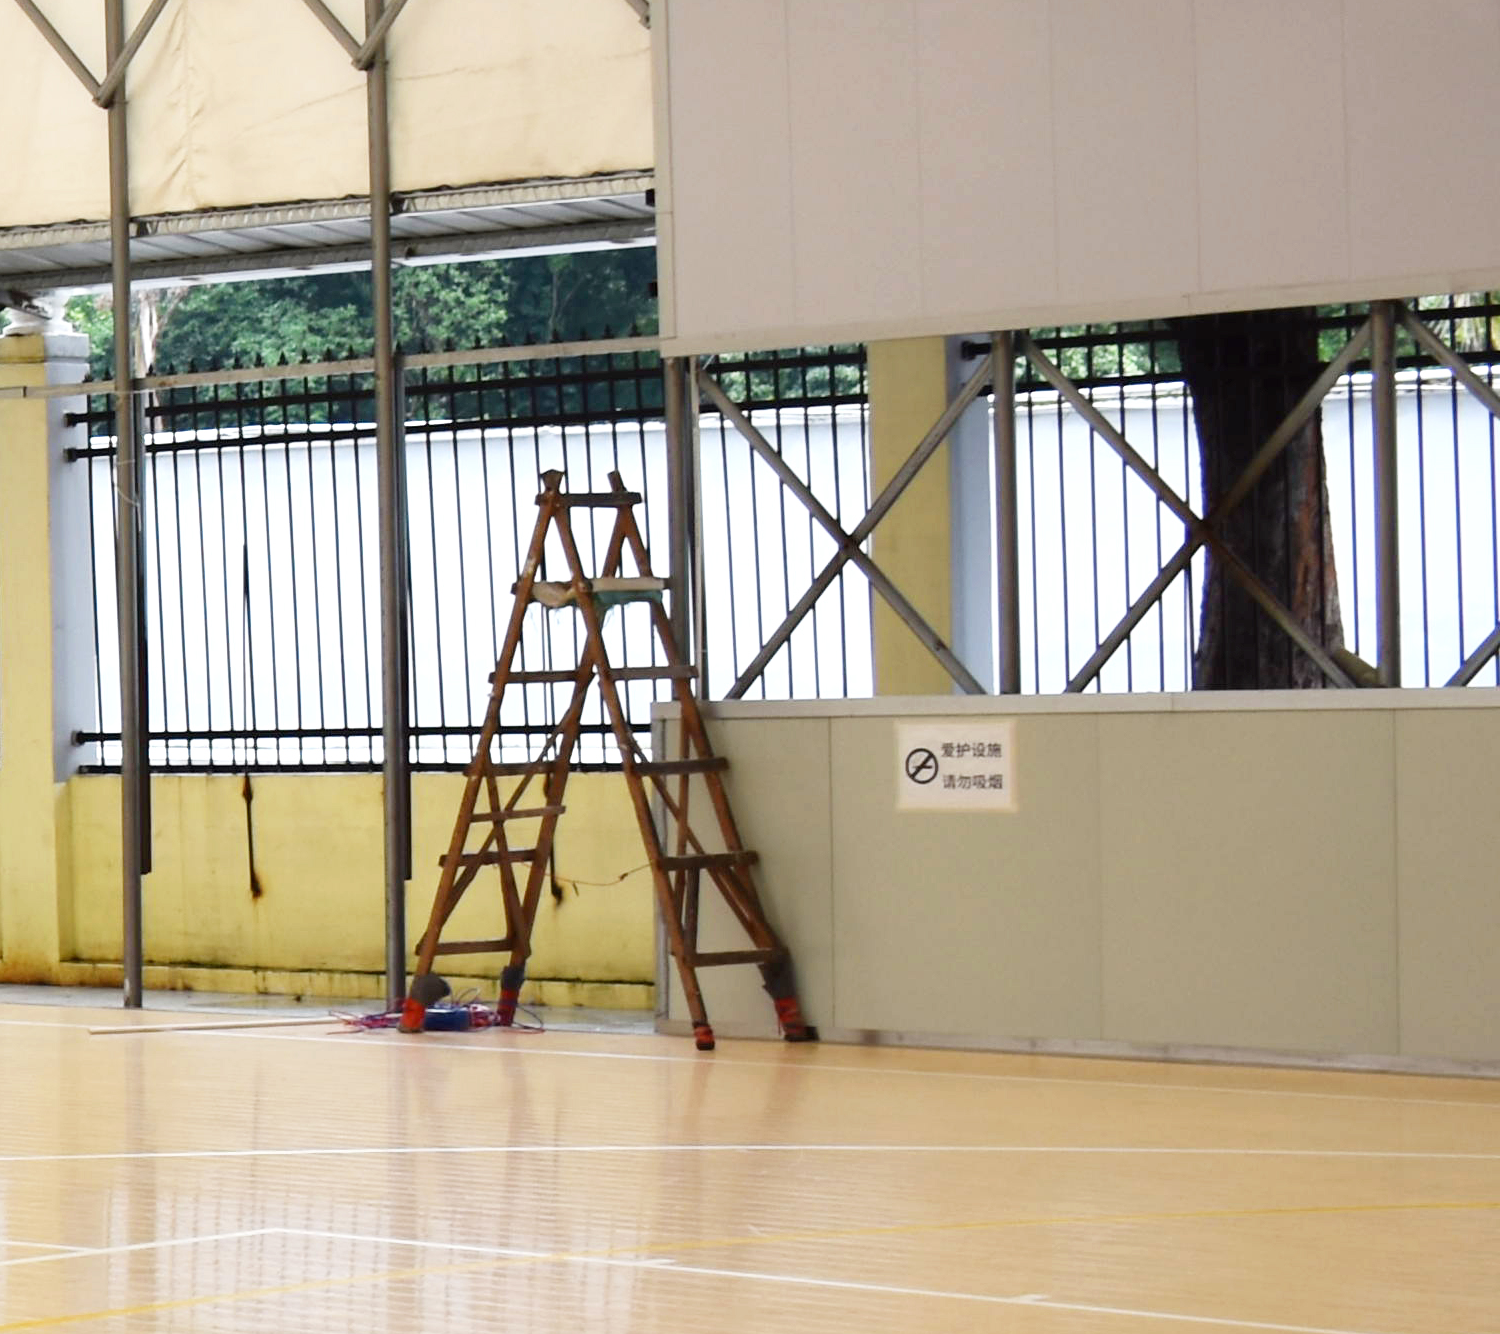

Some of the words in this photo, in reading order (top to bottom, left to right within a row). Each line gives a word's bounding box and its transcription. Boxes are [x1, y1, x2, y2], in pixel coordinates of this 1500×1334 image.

[941, 742, 1002, 758] 爱护设施
[942, 774, 1003, 790] 请勿吸烟
